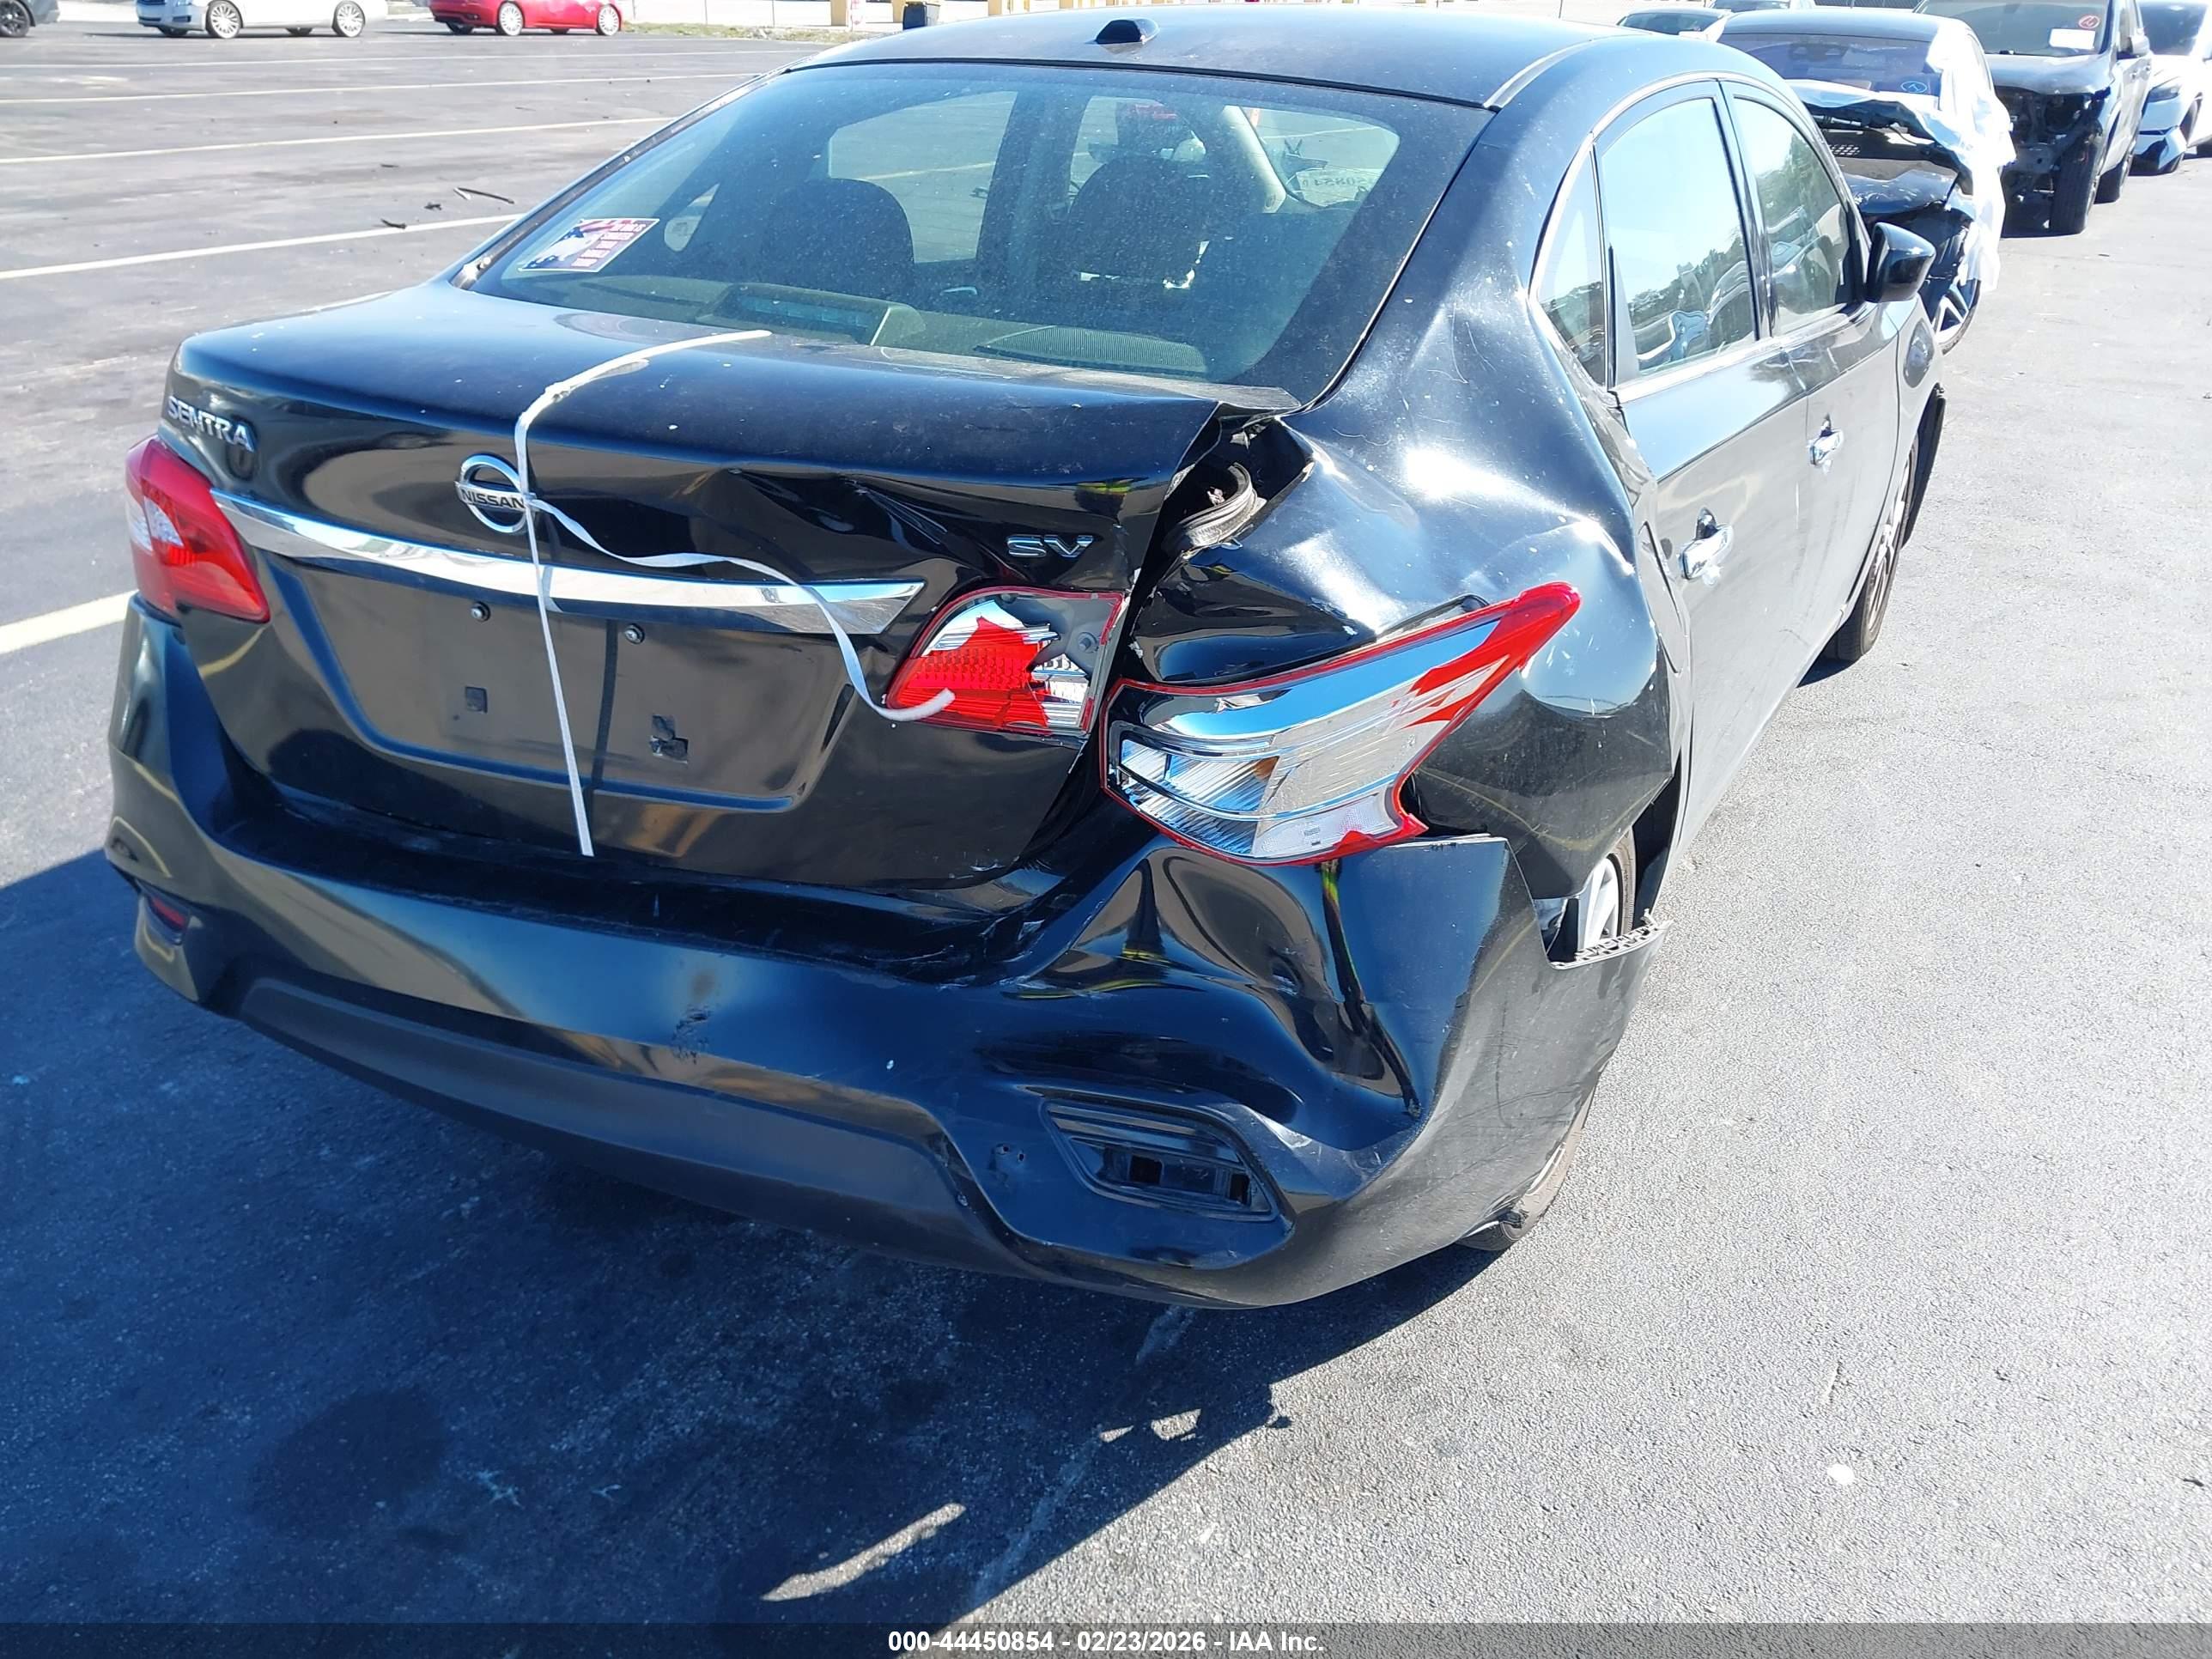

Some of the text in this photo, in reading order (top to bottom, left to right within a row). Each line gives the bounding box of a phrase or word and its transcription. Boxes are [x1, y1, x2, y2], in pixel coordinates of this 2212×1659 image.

[168, 395, 254, 453] SENTRA
[460, 488, 526, 509] NISSAN
[1006, 534, 1094, 558] SV
